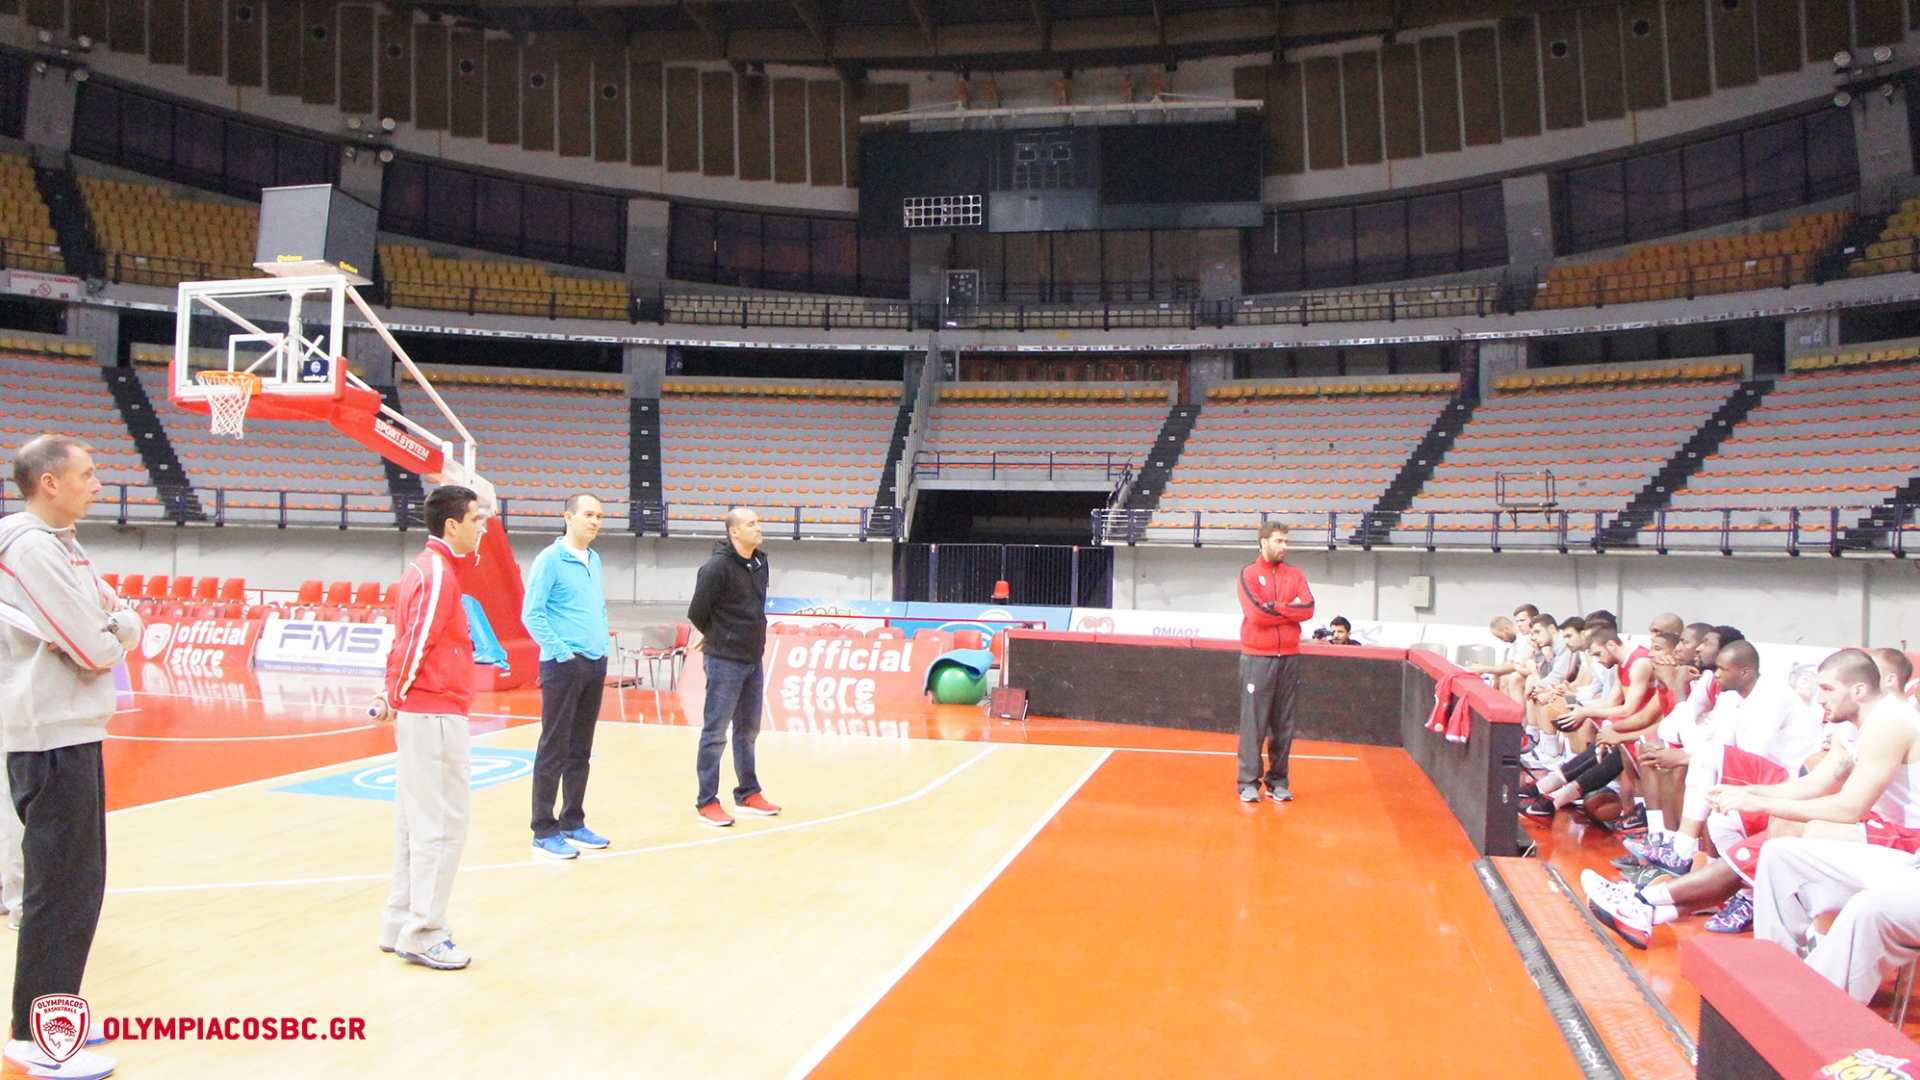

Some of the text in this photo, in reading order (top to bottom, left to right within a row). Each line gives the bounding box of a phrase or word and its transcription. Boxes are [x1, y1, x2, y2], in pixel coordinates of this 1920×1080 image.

[374, 418, 430, 460] SPORT SYSTEM
[176, 620, 250, 645] official
[279, 623, 384, 655] FMS
[170, 646, 224, 667] store
[787, 638, 913, 673] official
[781, 669, 876, 701] store
